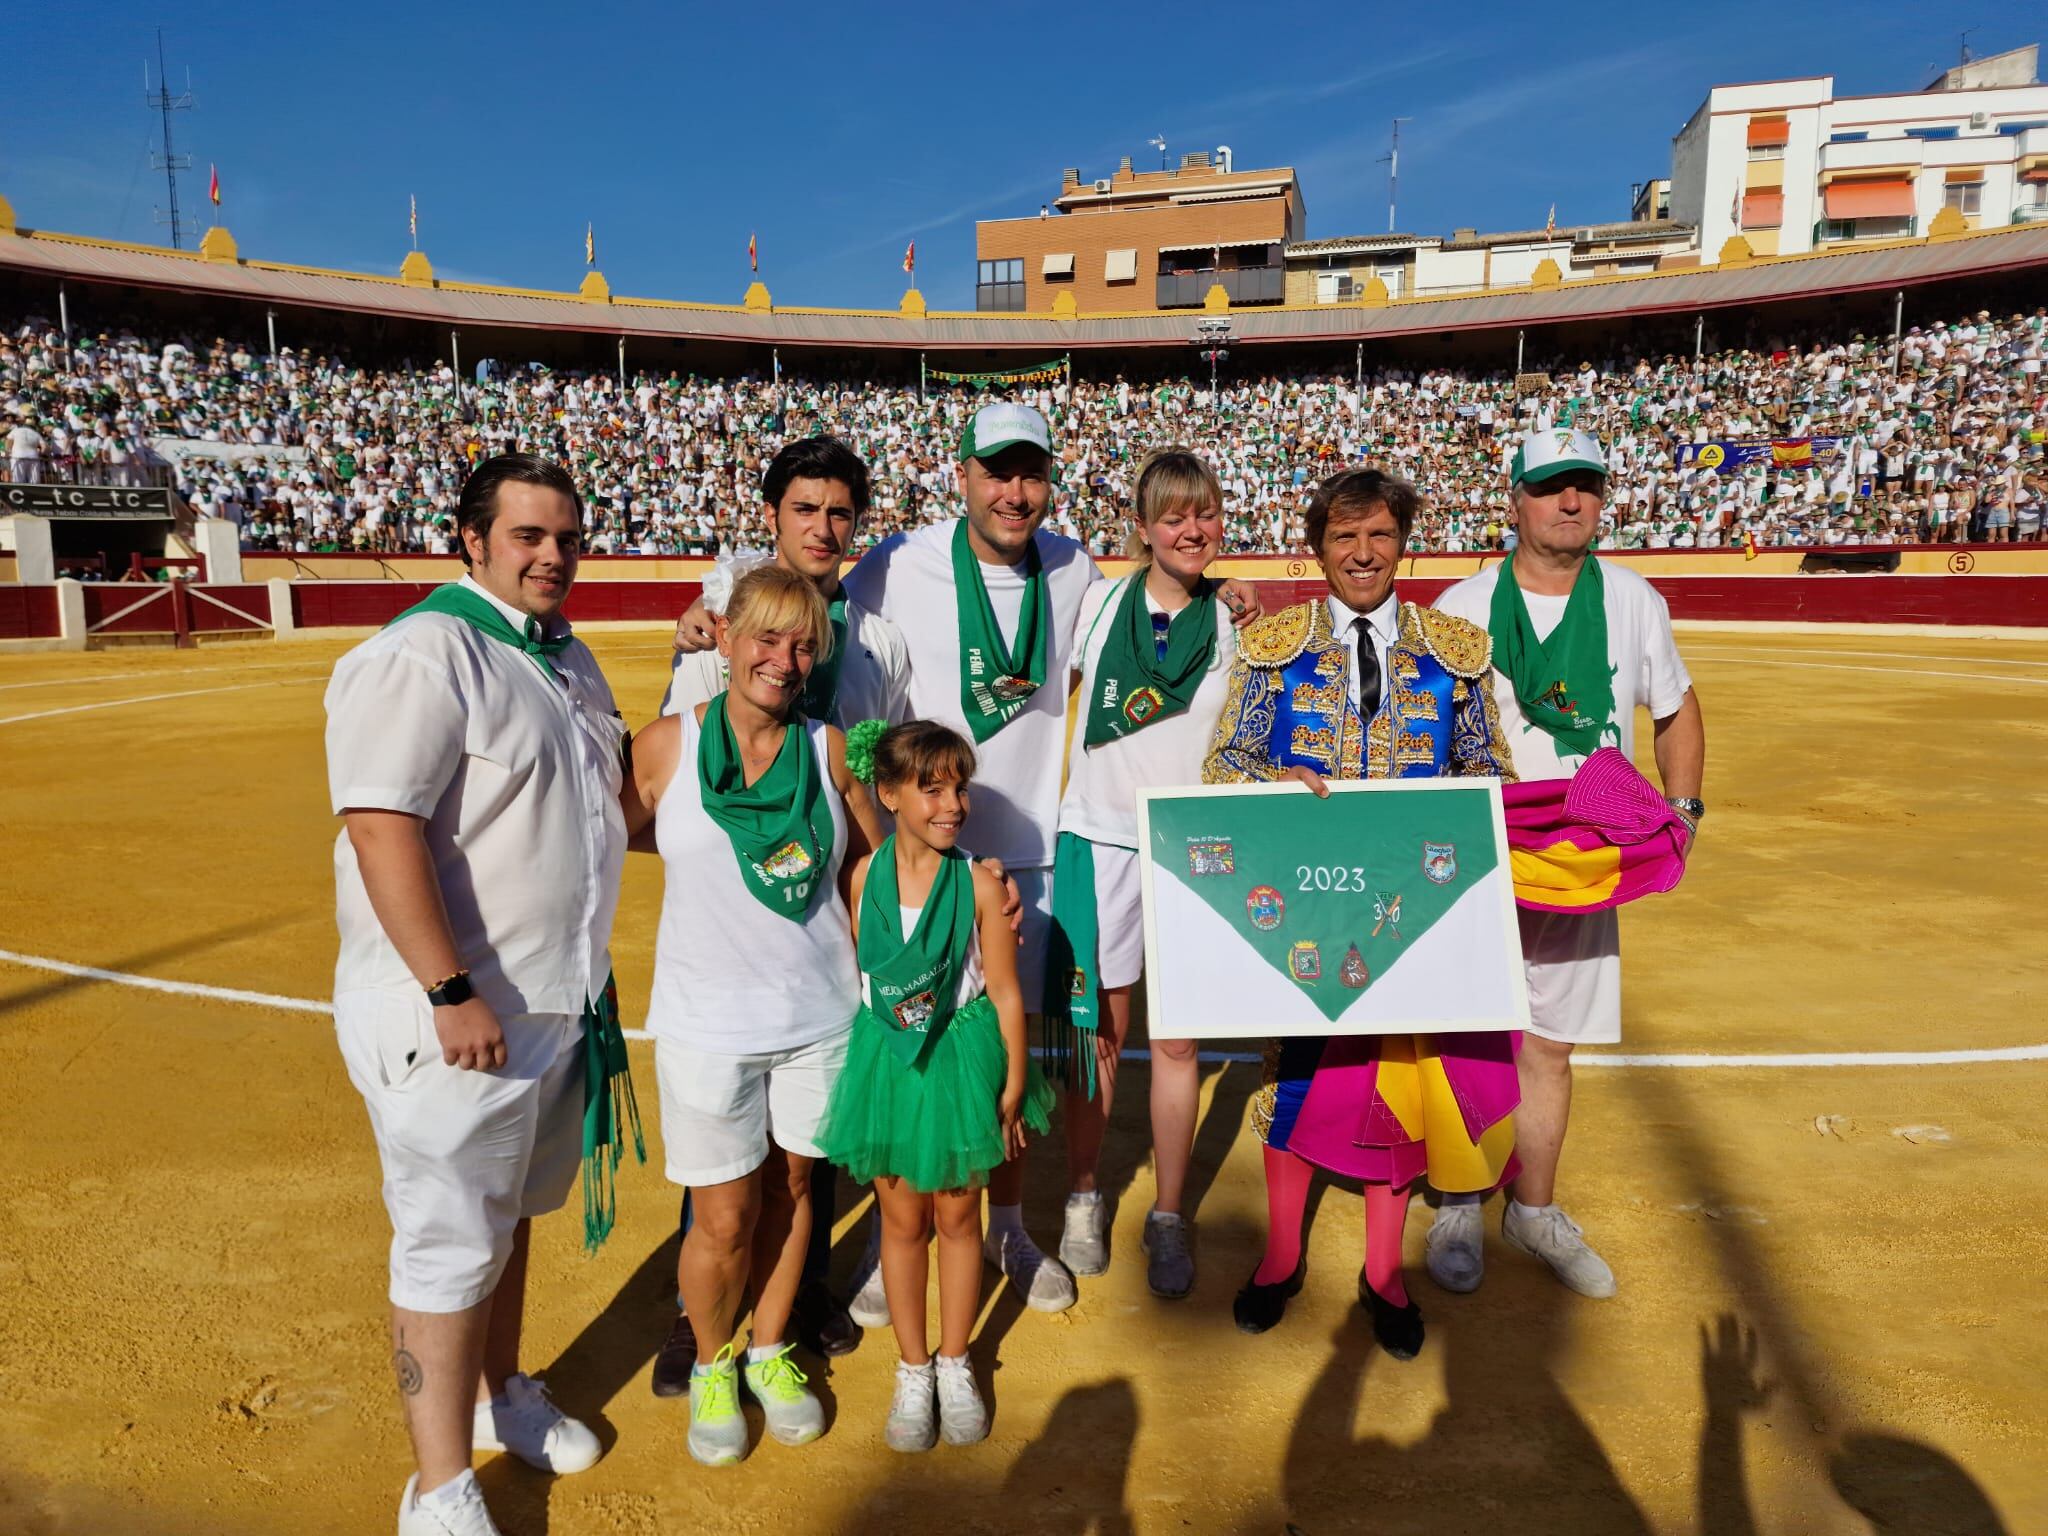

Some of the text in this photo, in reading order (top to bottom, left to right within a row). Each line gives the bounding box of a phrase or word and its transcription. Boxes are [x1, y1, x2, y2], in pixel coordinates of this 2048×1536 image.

[1293, 563, 1301, 575] 5
[1957, 555, 1967, 571] 5
[968, 647, 985, 676] PEÑA
[1102, 679, 1120, 709] PEÑA
[1296, 865, 1366, 893] 2023
[783, 882, 809, 903] 10
